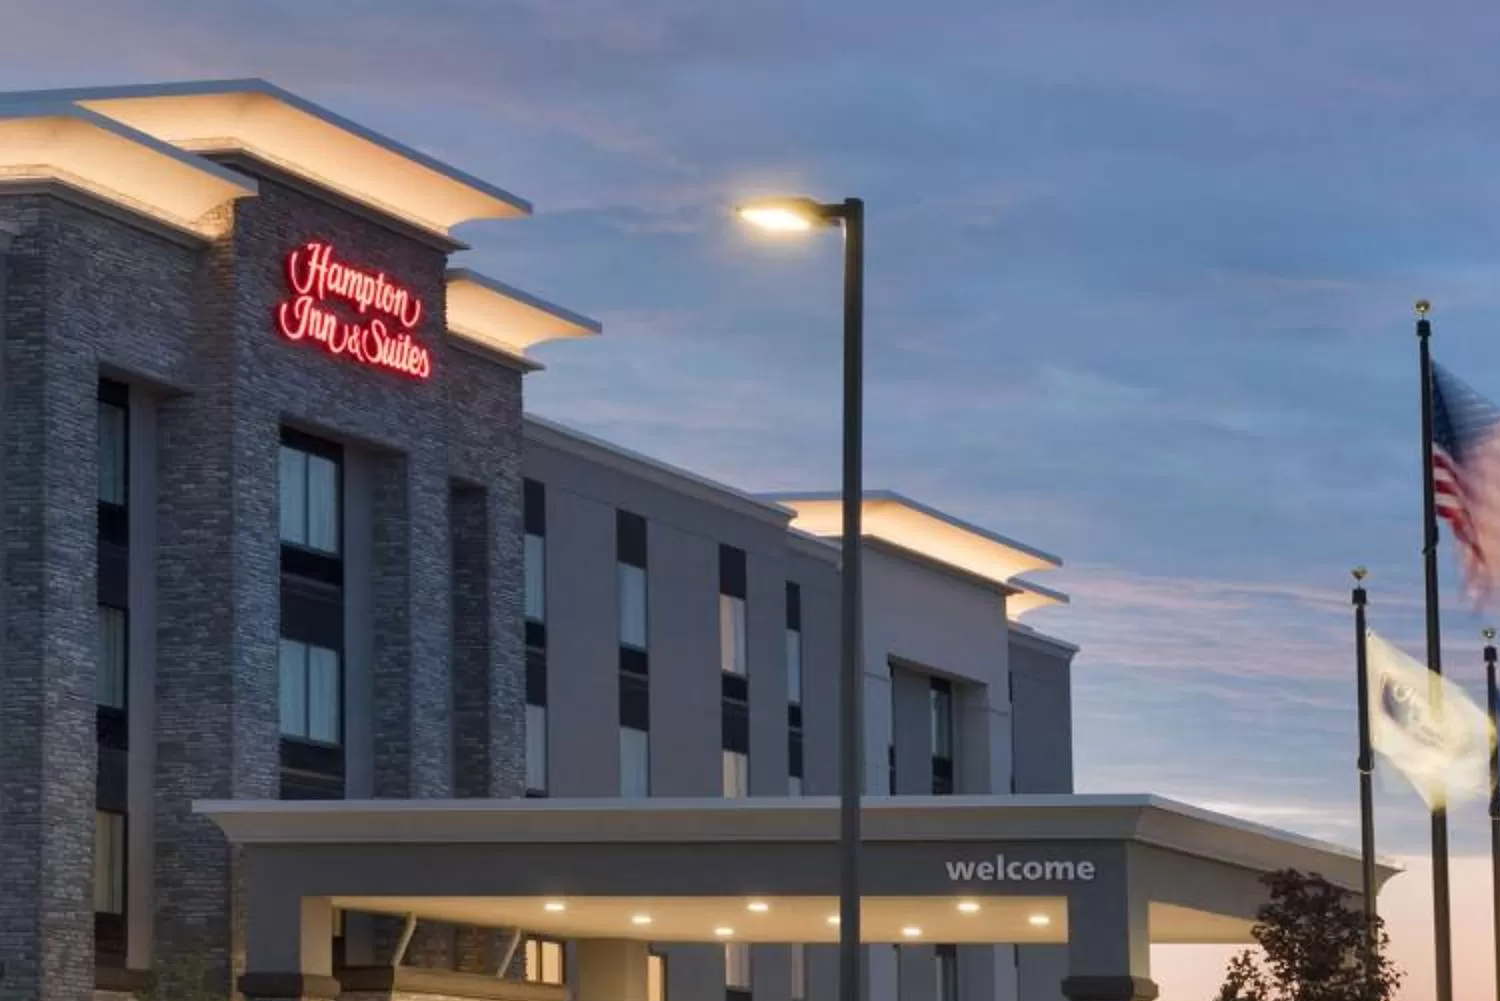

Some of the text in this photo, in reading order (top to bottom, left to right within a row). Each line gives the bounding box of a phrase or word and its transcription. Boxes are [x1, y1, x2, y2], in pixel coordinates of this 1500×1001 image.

[290, 243, 421, 328] Hampton
[279, 295, 430, 378] Inn & Suites
[945, 853, 1096, 881] welcome
